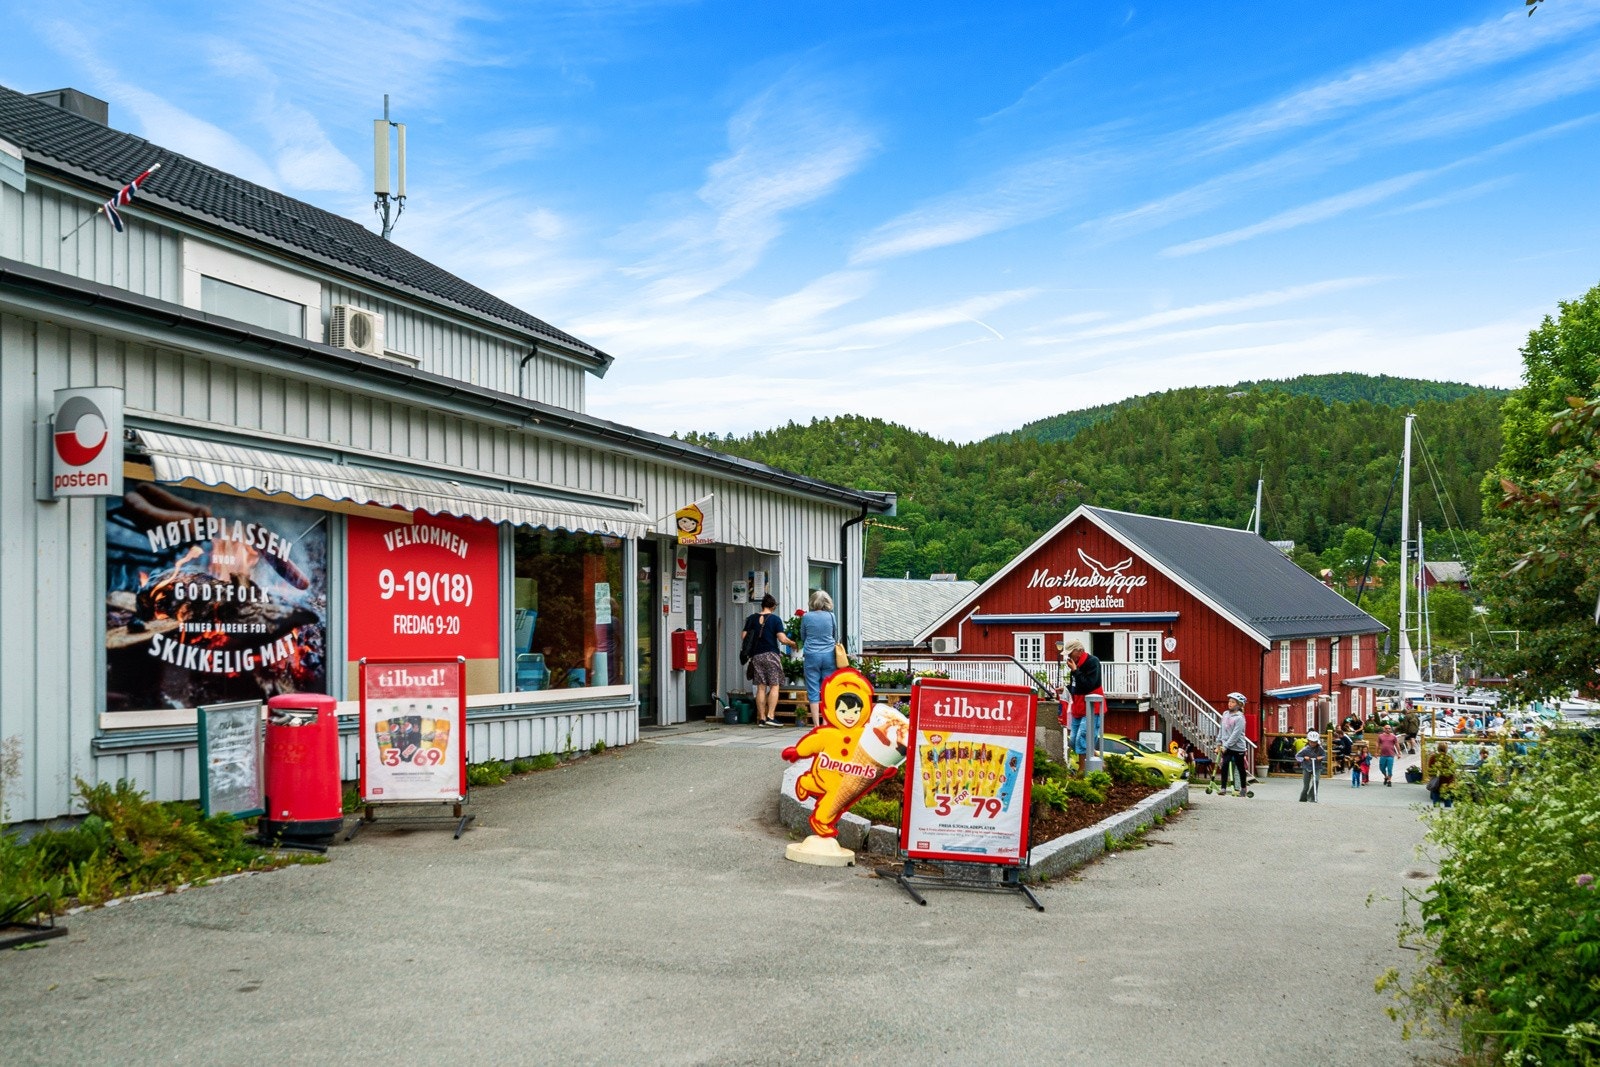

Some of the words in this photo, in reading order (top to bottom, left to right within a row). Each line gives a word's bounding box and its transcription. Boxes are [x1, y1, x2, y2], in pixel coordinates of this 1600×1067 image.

[55, 470, 108, 491] posten
[146, 517, 293, 562] MØTEPLASSEN
[383, 525, 469, 559] VELKOMMEN
[175, 582, 270, 603] GODTFOLK
[378, 568, 473, 607] 9-19(18)
[1027, 567, 1148, 594] Marthabrygga
[179, 622, 212, 633] FINNER
[215, 623, 248, 633] VARENE
[250, 623, 267, 634] FOR
[393, 615, 434, 634] FREDAG
[436, 616, 460, 634] 9-20
[148, 633, 255, 673] SKIKKELIG
[259, 633, 297, 667] MAT
[378, 669, 446, 687] tilbud!
[934, 697, 1013, 721] tilbud!
[385, 750, 400, 767] 3
[413, 749, 441, 766] 69
[934, 795, 952, 817] 3
[954, 790, 969, 805] FOR
[971, 798, 1002, 819] 79
